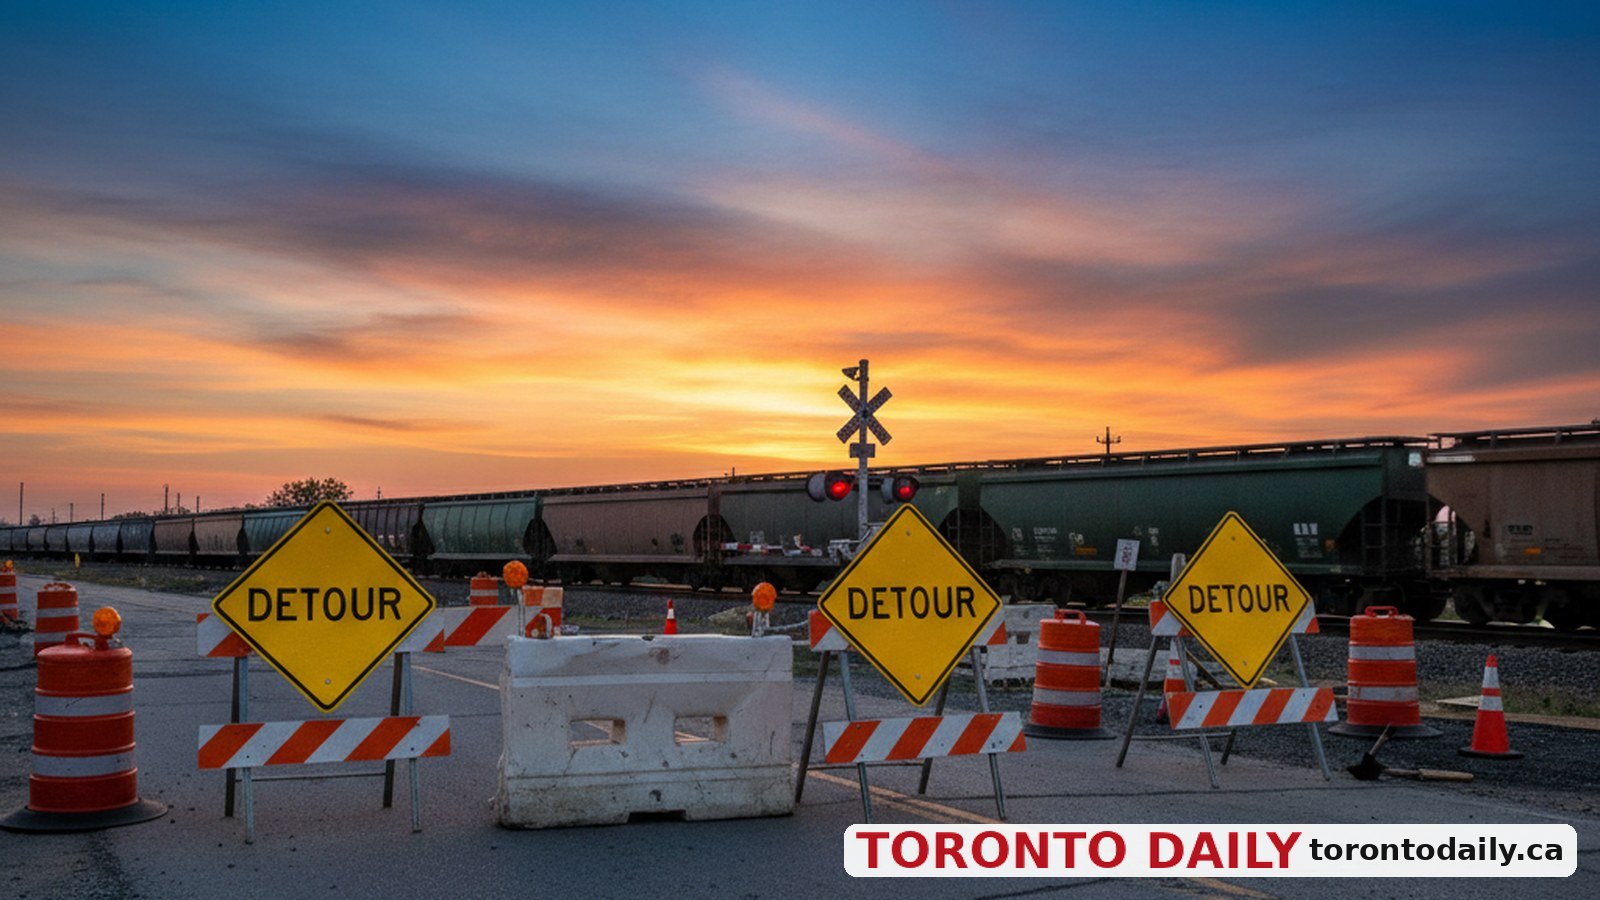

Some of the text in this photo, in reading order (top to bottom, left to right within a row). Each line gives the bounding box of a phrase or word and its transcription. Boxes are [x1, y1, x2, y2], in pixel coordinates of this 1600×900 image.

[247, 586, 402, 623] DETOUR
[847, 585, 977, 620] DETOUR
[1187, 583, 1291, 615] DETOUR
